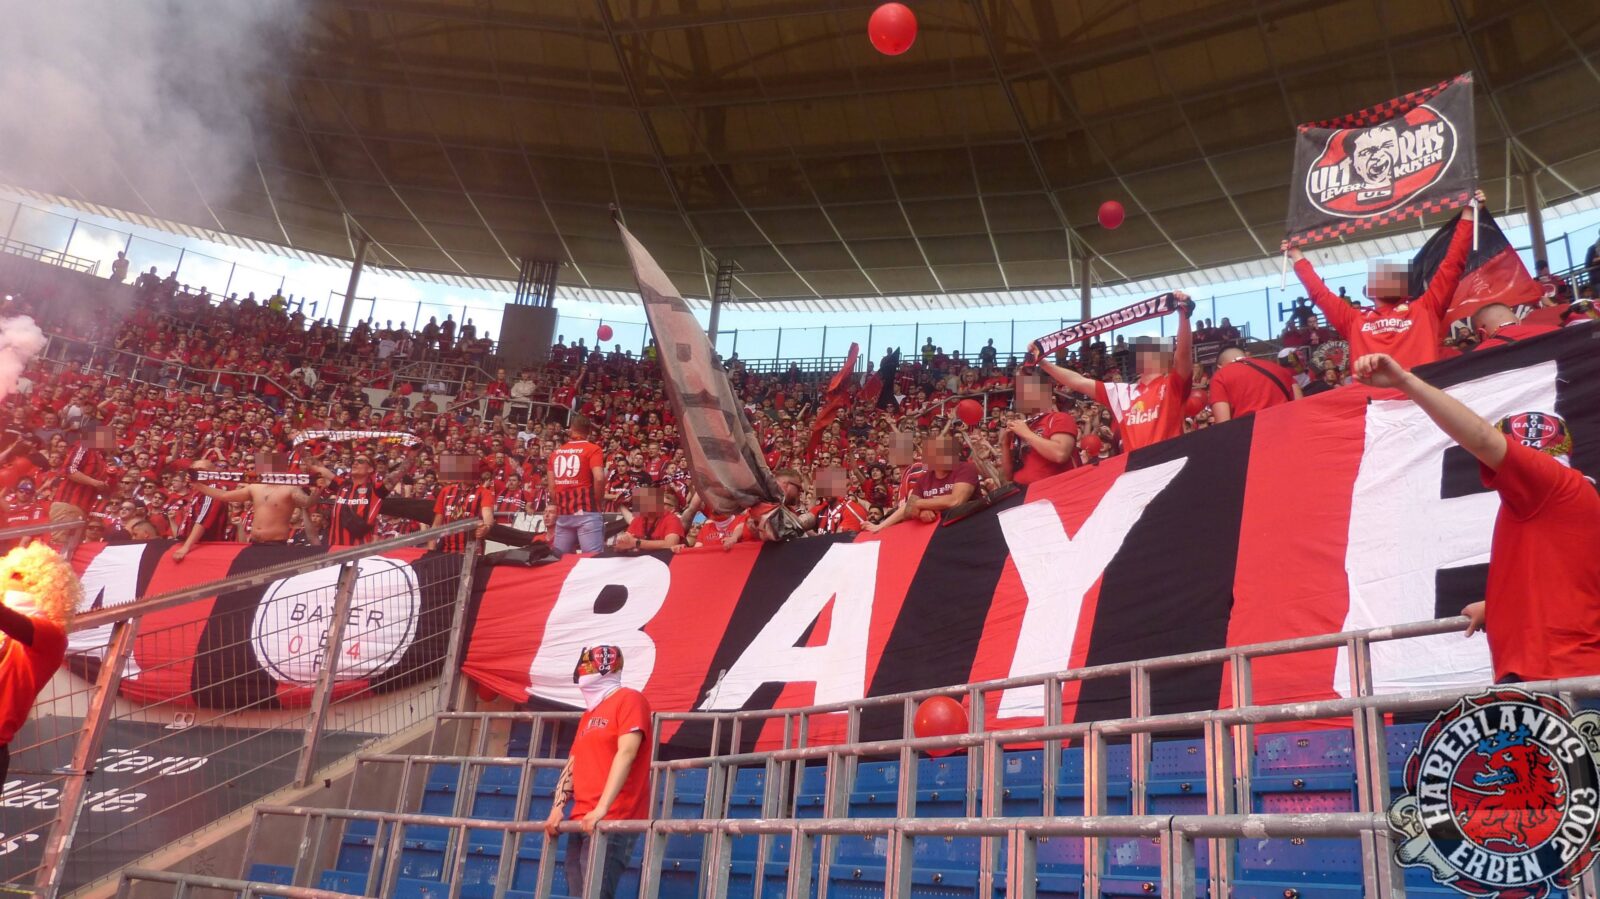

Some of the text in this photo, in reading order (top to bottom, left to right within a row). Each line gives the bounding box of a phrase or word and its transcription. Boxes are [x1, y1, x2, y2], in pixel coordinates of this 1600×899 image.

[1393, 149, 1443, 178] KUSEN
[1513, 421, 1553, 432] BAYER
[1520, 439, 1542, 448] 04
[553, 454, 581, 478] 09
[290, 603, 384, 629] BAER
